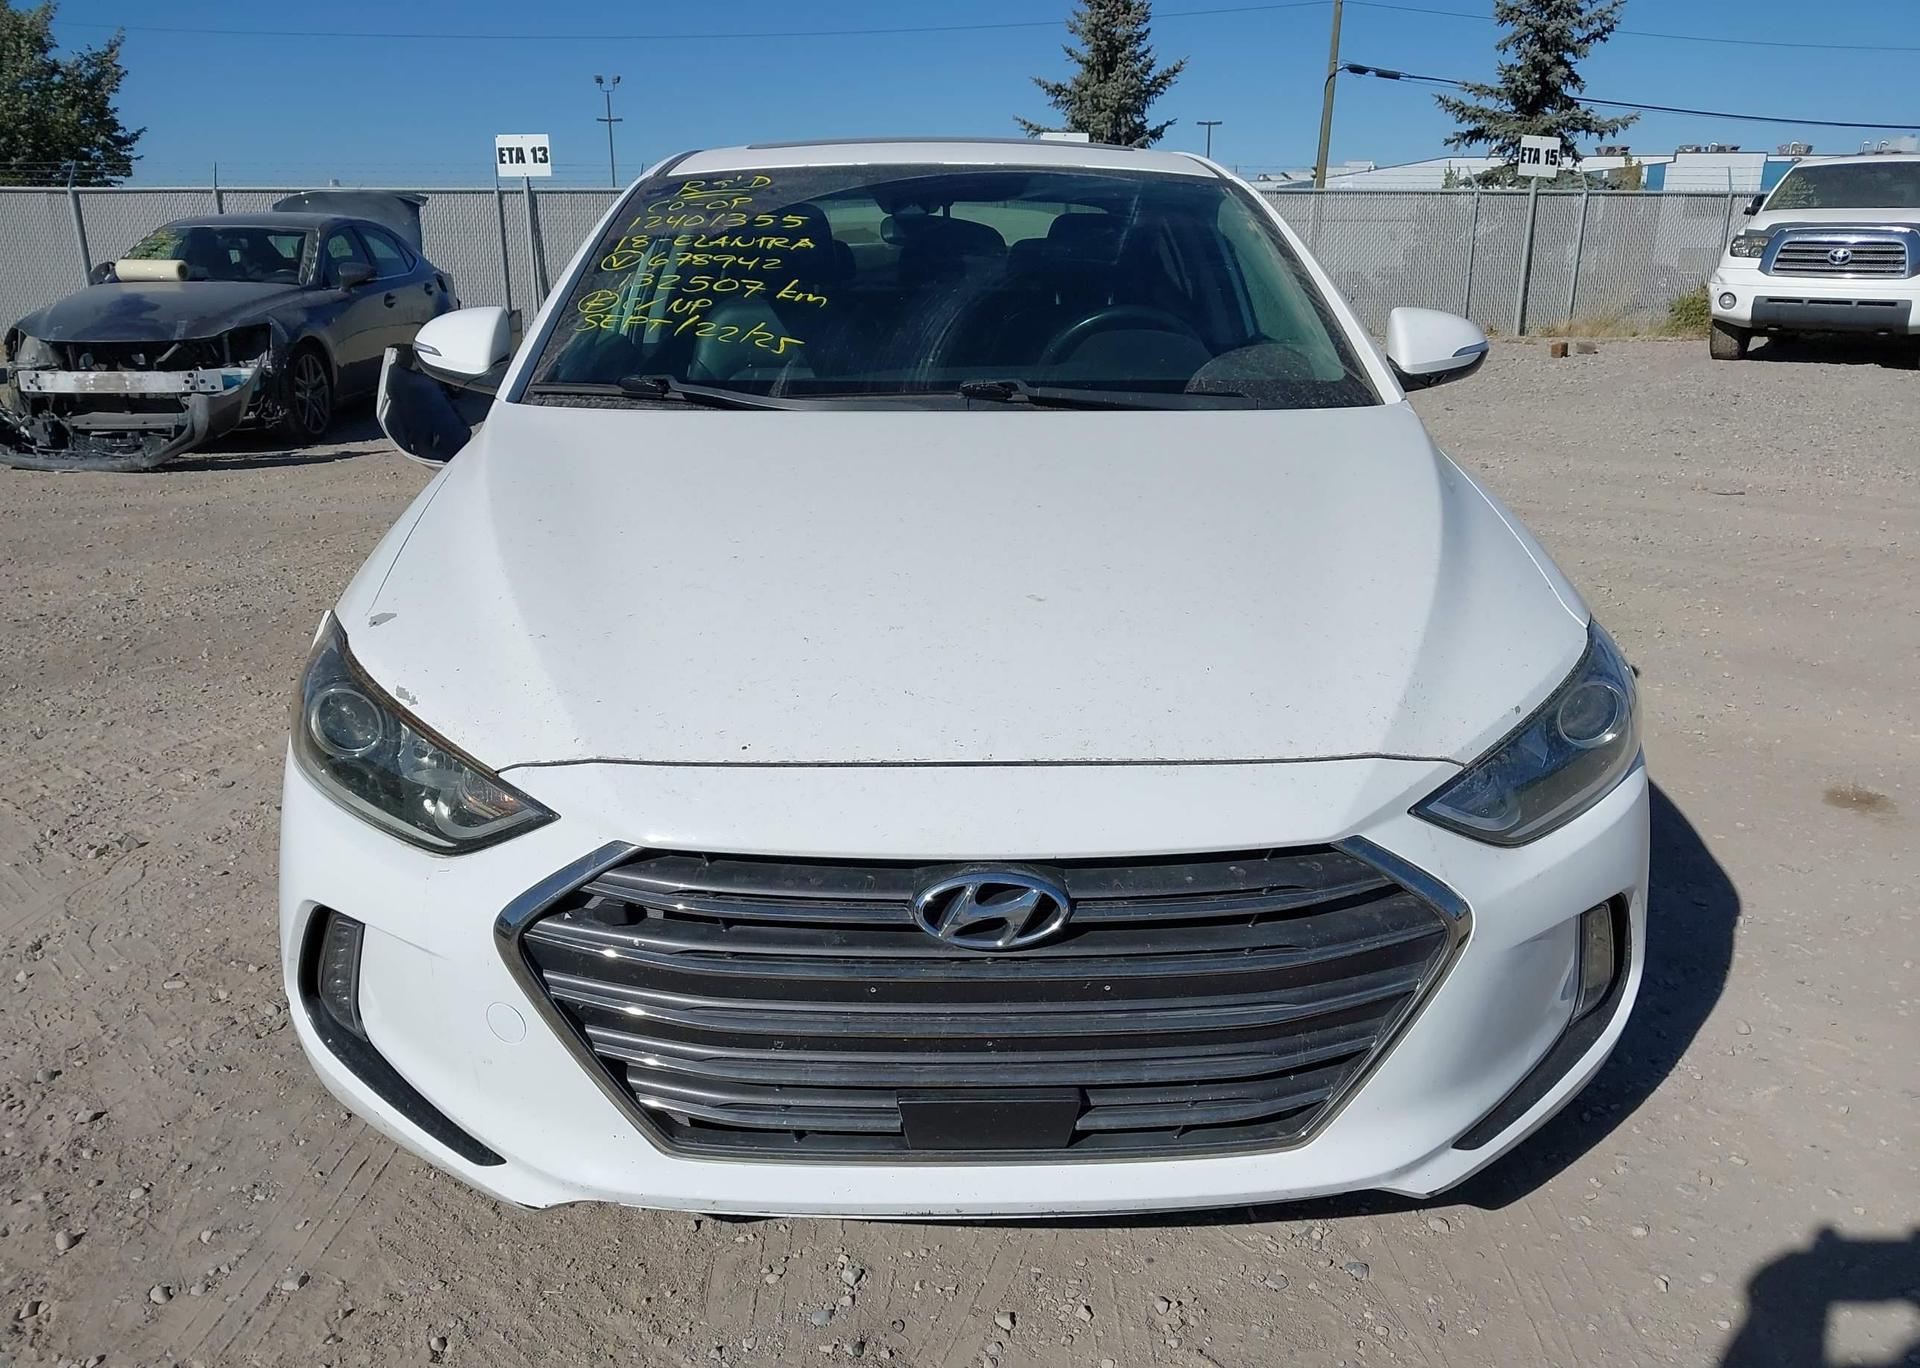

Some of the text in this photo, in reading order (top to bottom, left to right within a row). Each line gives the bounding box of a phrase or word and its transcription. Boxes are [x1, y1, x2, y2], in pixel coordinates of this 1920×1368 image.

[498, 146, 549, 164] ETA 13
[1520, 147, 1558, 166] ETA 15
[627, 214, 810, 233] 12401355
[647, 252, 783, 269] 678942
[619, 273, 767, 298] 132507
